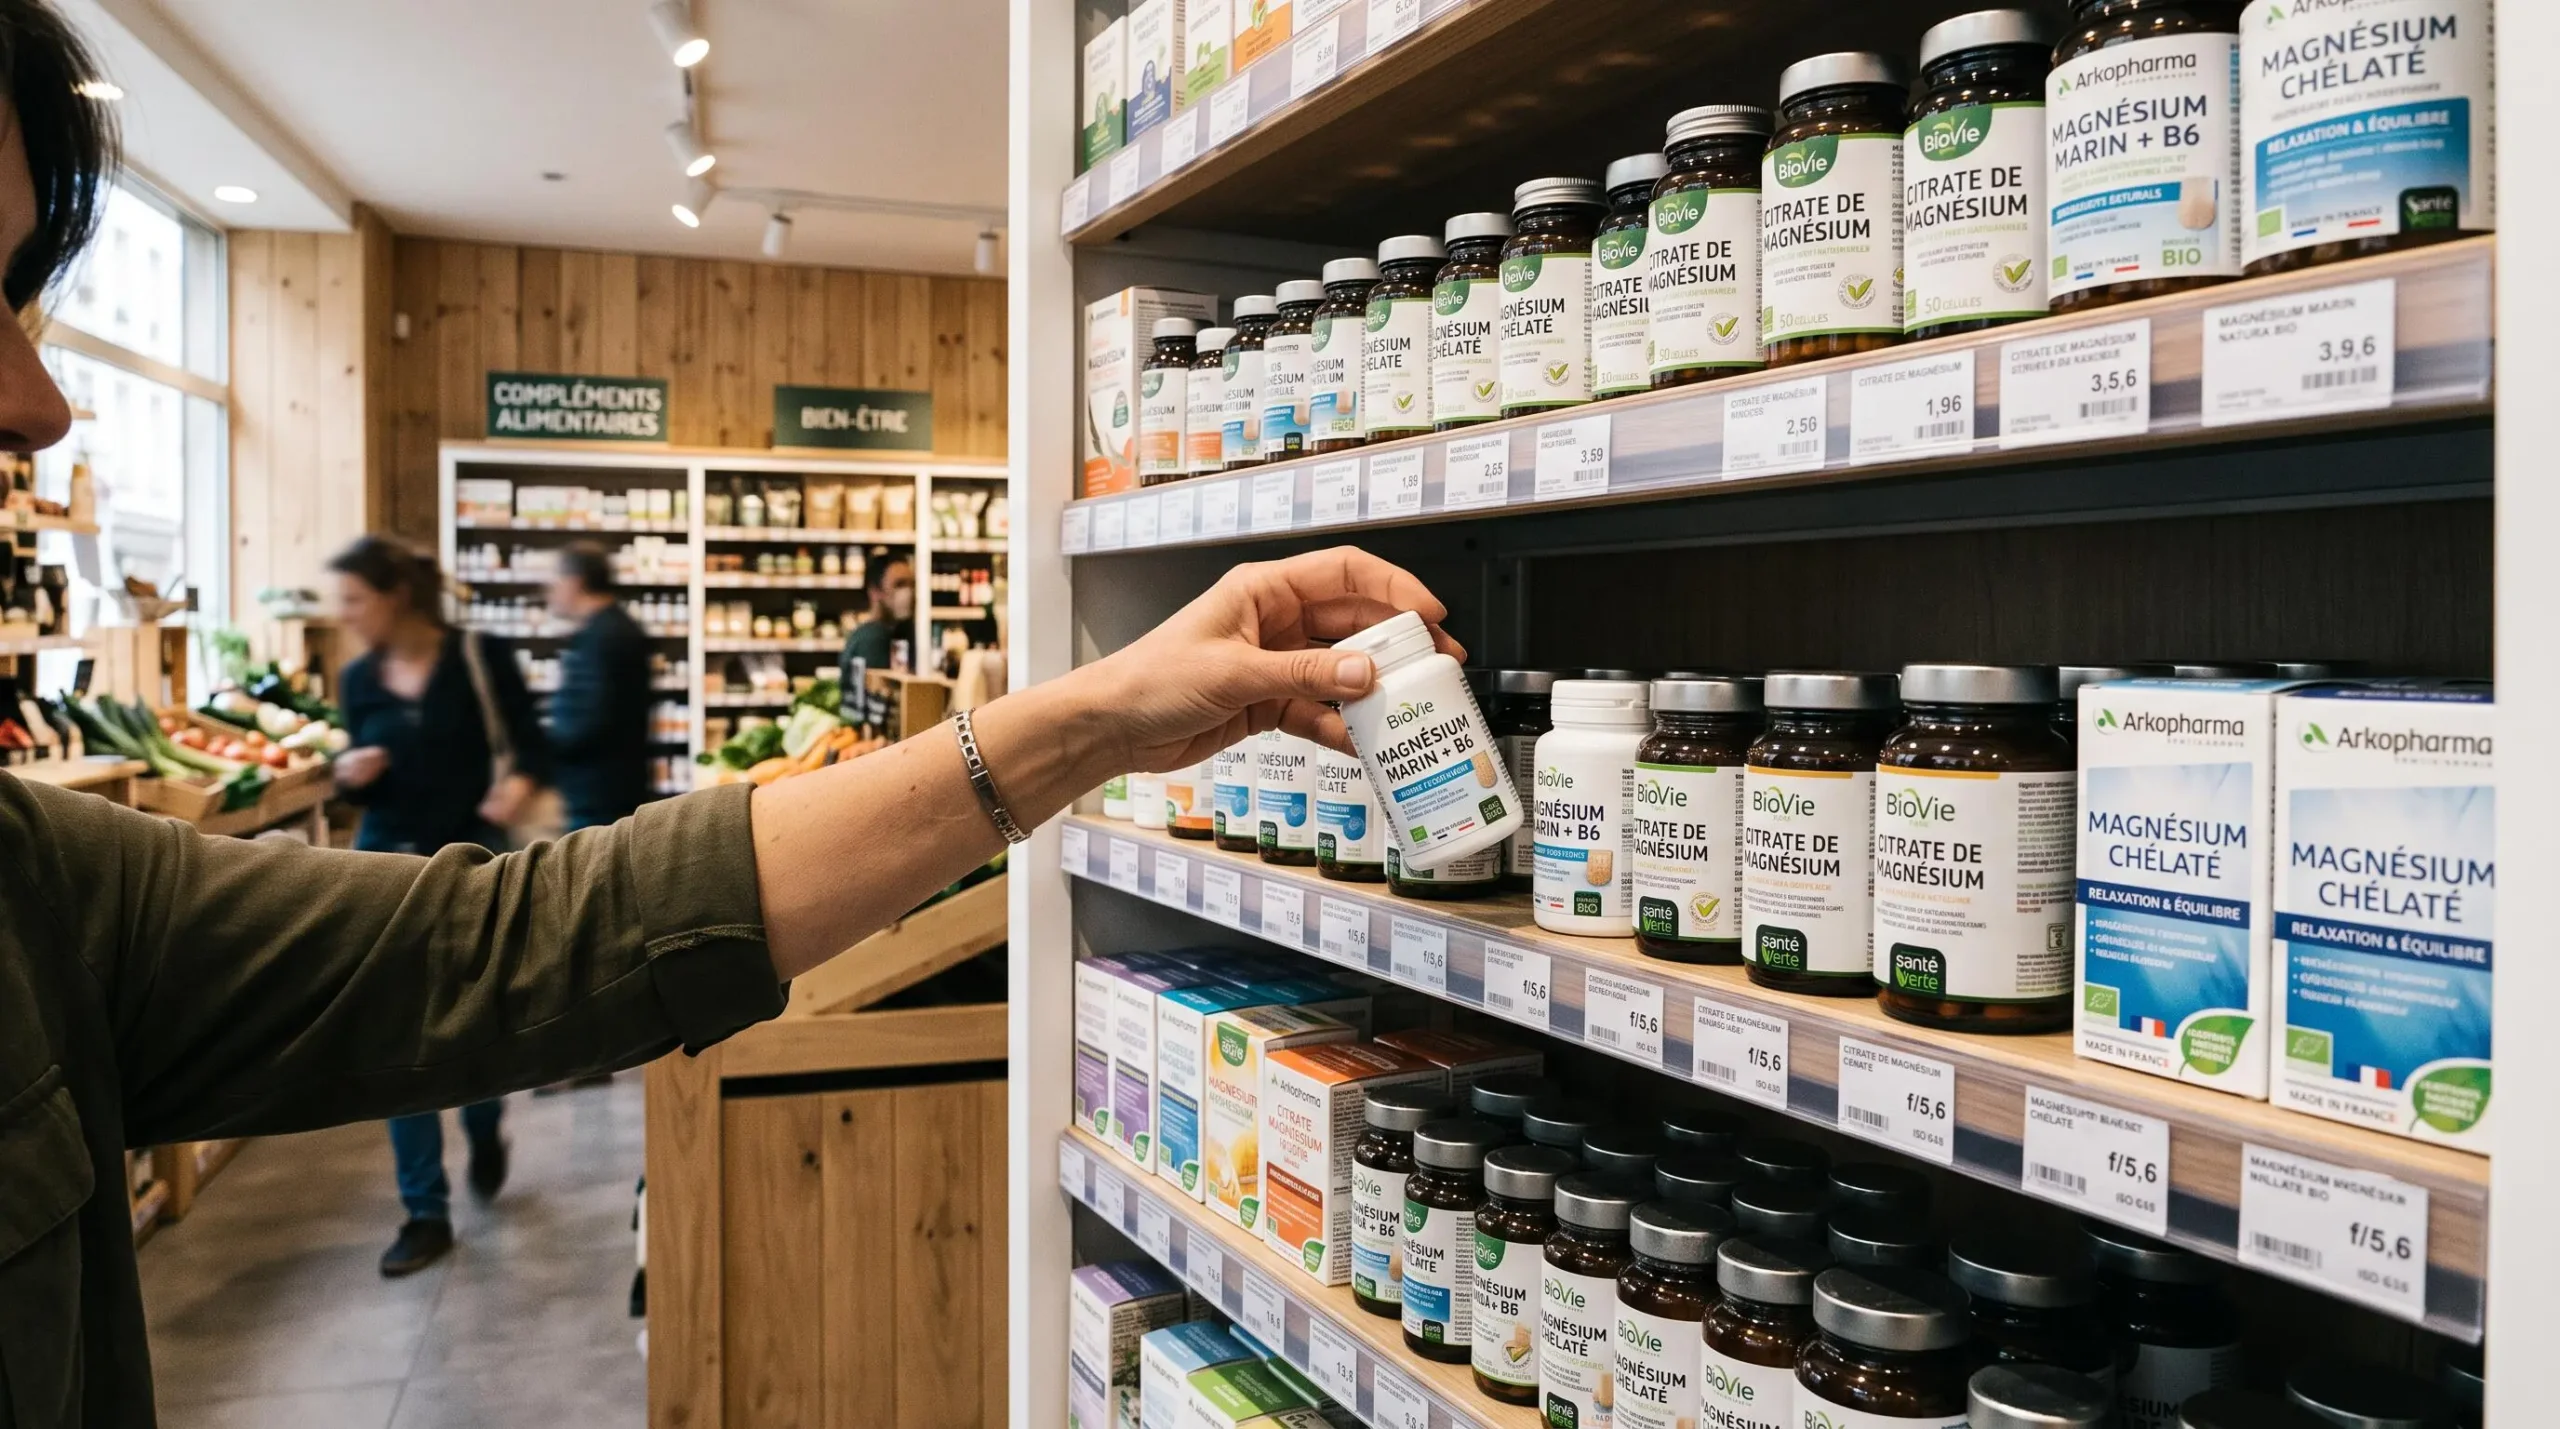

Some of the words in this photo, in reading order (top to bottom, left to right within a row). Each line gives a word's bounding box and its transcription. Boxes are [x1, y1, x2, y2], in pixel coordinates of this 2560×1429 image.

[2261, 15, 2458, 78] MAGNÉSIUM
[2075, 52, 2198, 91] Arkopharma
[2280, 44, 2427, 99] CHÉLATÉ
[2051, 95, 2207, 147] MAGNÉSIUM
[2266, 122, 2349, 156] RELAXATION
[2352, 118, 2366, 135] &
[2367, 109, 2450, 133] ÉQUILIBRE
[2054, 132, 2128, 172] MARIN
[2136, 132, 2154, 149] +
[2163, 123, 2201, 148] B6
[1906, 169, 1983, 206] CITRATE
[1990, 166, 2023, 189] DE
[1764, 195, 1830, 229] CITRATE
[1836, 192, 1865, 213] DE
[1904, 193, 2028, 235] MAGNÉSIUM
[1706, 240, 1733, 259] DE
[2162, 248, 2202, 268] BIO
[1592, 276, 1643, 303] CITRATE
[2218, 305, 2303, 330] MAGNÉSIUM
[2308, 297, 2357, 316] MARIN
[2273, 321, 2298, 337] BIO
[2318, 335, 2377, 363] 3,9,6
[1858, 374, 1894, 388] CITRATE
[1894, 370, 1907, 382] DE
[2090, 368, 2138, 394] 3,5,6
[494, 380, 663, 411] COMPLÉMENTS
[1926, 395, 1963, 418] 1,96
[495, 408, 660, 437] ALIMENTAIRES
[800, 405, 909, 434] BIEN-ÊTRE
[1387, 700, 1435, 730] BioVie
[2123, 711, 2245, 737] Arkopharma
[1375, 714, 1471, 768] MAGNÉSIUM
[2336, 727, 2493, 756] Arkopharma
[1386, 752, 1439, 784] MARIN
[1442, 747, 1452, 758] +
[1455, 734, 1475, 755] B6
[1537, 768, 1574, 790] BioVie
[1637, 780, 1688, 809] BioVie
[1752, 785, 1816, 818] BioVie
[1887, 787, 1956, 823] BioVie
[1534, 799, 1605, 823] AGNÉSIUM
[1563, 826, 1573, 837] +
[1577, 824, 1601, 841] B6
[1683, 824, 1707, 841] DE
[1745, 827, 1806, 853] CITRATE
[1811, 835, 1840, 854] DE
[2088, 810, 2247, 849] MAGNÉSIUM
[1878, 834, 1945, 862] CITRATE
[1953, 842, 1983, 865] DE
[2108, 842, 2221, 880] CHÉLATÉ
[1744, 852, 1841, 878] MAGNÉSIUM
[1876, 858, 1985, 891] MAGNÉSIUM
[2292, 841, 2495, 889] MAGNÉSIUM
[1642, 905, 1673, 920] santé
[2088, 886, 2161, 909] RELAXATION
[2162, 898, 2172, 911] &
[2173, 896, 2241, 920] ÉQUILIBRE
[2318, 880, 2463, 923] CHÉLATÉ
[1761, 933, 1800, 953] santé
[2291, 921, 2383, 949] RELAXATION
[2386, 936, 2398, 950] &
[2401, 934, 2486, 964] ÉQUILIBRE
[1895, 953, 1939, 973] santé
[1523, 979, 1547, 1000] f/5,6
[1629, 1011, 1659, 1034] f/5,6
[1698, 1004, 1725, 1021] CITRATE
[1726, 1012, 1736, 1022] DE
[1843, 1045, 1877, 1063] CITRATE
[1878, 1053, 1889, 1065] DE
[2085, 1039, 2113, 1056] MADE
[2115, 1046, 2127, 1059] IN
[1906, 1092, 1947, 1120] f/5,6
[2288, 1089, 2325, 1107] MADE
[2329, 1098, 2342, 1111] IN
[1277, 1104, 1312, 1132] CITRATE
[1912, 1128, 1927, 1141] ISO
[2108, 1151, 2158, 1184] f/5,6
[1379, 1224, 1396, 1238] B6
[2349, 1222, 2413, 1261] f/5,6
[1544, 1278, 1586, 1309] BioVie
[1500, 1300, 1519, 1317] B6
[1618, 1319, 1663, 1352] BioVie
[1706, 1365, 1755, 1401] BioVie
